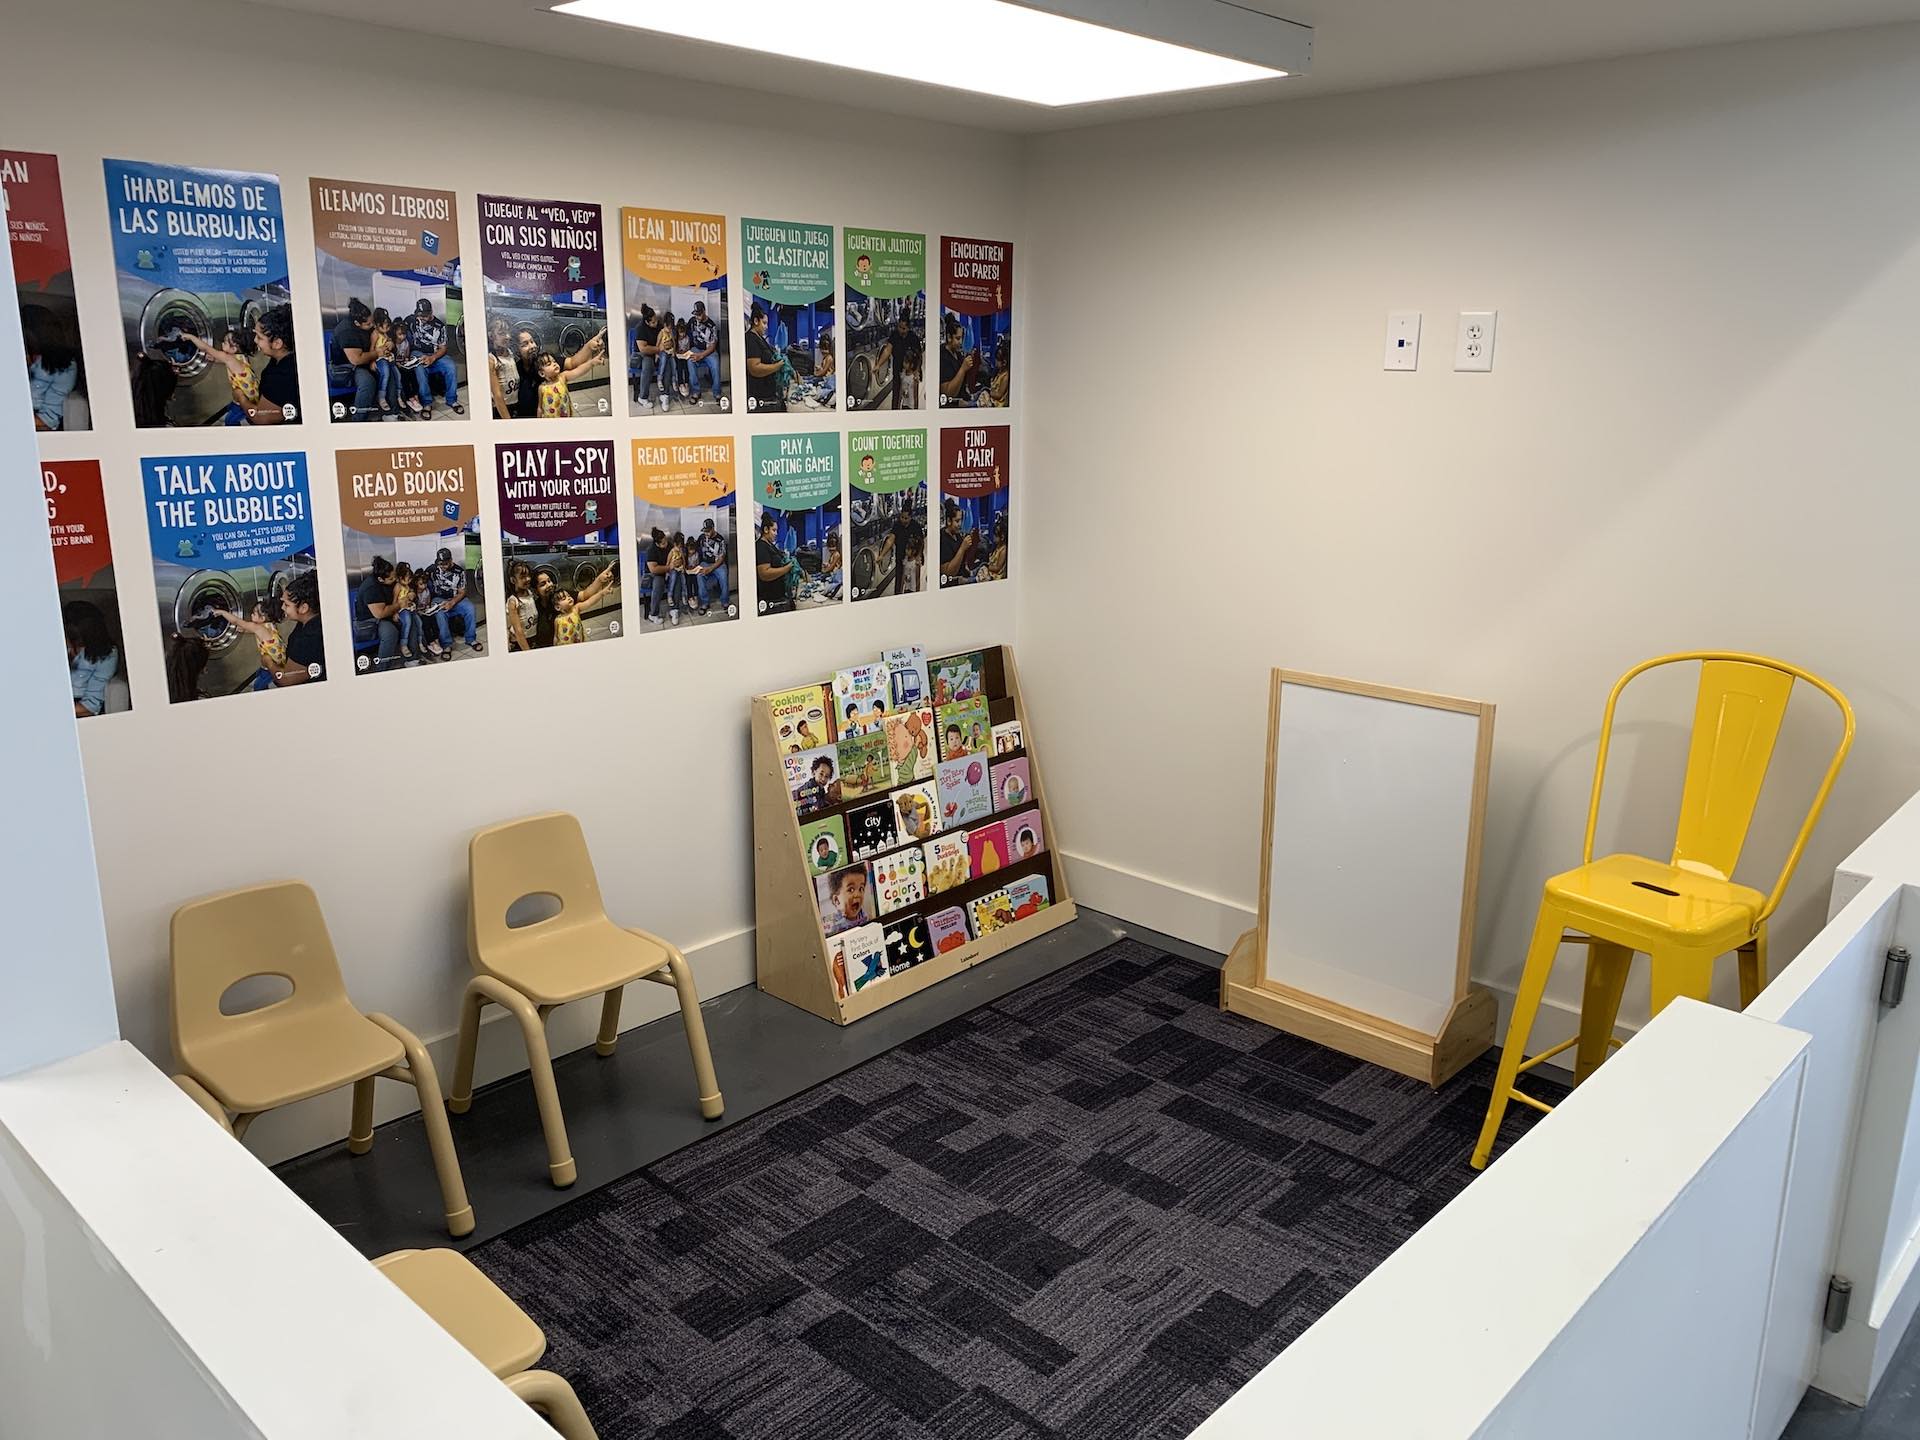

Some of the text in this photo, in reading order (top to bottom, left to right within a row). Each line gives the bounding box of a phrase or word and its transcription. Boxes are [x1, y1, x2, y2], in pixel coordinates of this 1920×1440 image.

[122, 174, 267, 211] ¡HABLEMOS DE
[319, 187, 450, 222] ¡LEAMOS LIBROS!
[484, 201, 523, 220] ¡JUEGUE
[526, 206, 539, 221] AL
[119, 207, 277, 244] LAS BURBUJAS!
[628, 215, 721, 246] ¡LEAN JUNTOS!
[486, 224, 598, 252] CON SUS NIÑOS!
[746, 225, 829, 247] ¡JUEGUEN UN JUEGO
[847, 233, 922, 255] ¡CUENTEN JUNTOS!
[747, 245, 829, 269] DE CLASIFICAR!
[950, 241, 1004, 262] ¡ENCUENTREN
[954, 262, 1000, 281] LOS PARES!
[780, 438, 814, 456] PLAY A
[852, 433, 924, 453] COUNT TOGETHER!
[965, 430, 986, 448] FIND
[391, 451, 424, 470] LET'S
[502, 447, 609, 479] PLAY I-SPY
[637, 444, 730, 466] READ TOGETHER!
[956, 447, 995, 469] A PAIR!
[760, 456, 834, 476] SORTING GAME!
[154, 460, 296, 496] TALK ABOUT
[352, 466, 465, 498] READ BOOKS!
[504, 476, 611, 499] WITH YOUR CHILD!
[155, 492, 305, 529] THE BUBBLES!
[66, 524, 85, 534] YOUR
[212, 533, 224, 541] YOU
[271, 525, 284, 534] LOOK
[285, 524, 296, 532] FOR
[70, 534, 94, 546] BRAIN!
[253, 536, 270, 546] SMALL
[249, 548, 262, 556] THEY
[852, 667, 871, 678] WHAT
[772, 704, 804, 718] Cocino
[865, 815, 882, 828] City
[934, 844, 941, 855] 5
[884, 881, 917, 900] Colors
[852, 949, 871, 960] Colors
[889, 960, 911, 975] Home
